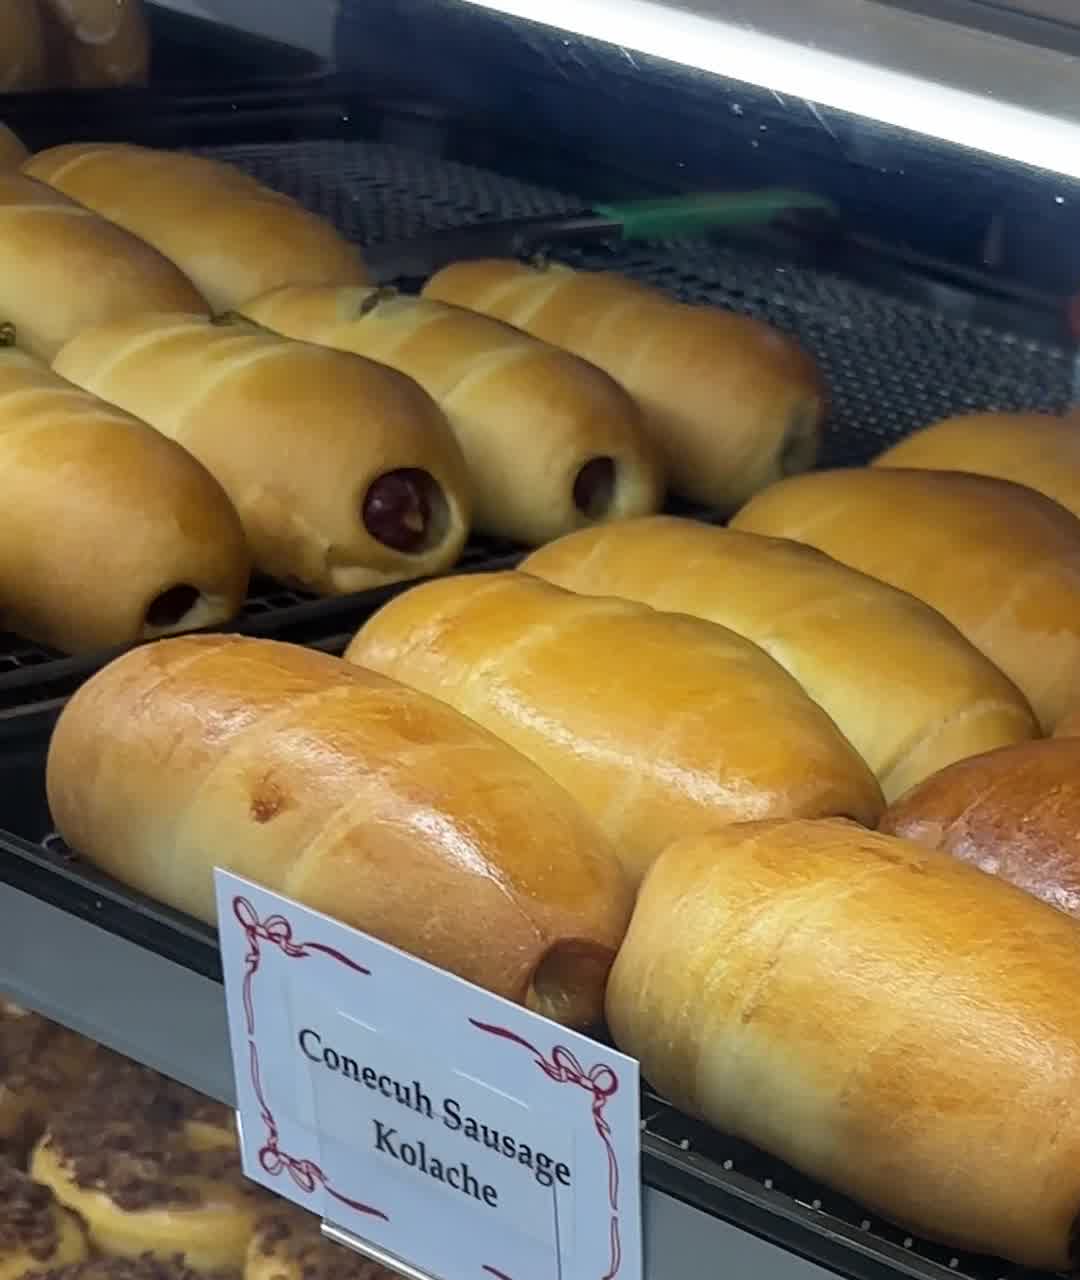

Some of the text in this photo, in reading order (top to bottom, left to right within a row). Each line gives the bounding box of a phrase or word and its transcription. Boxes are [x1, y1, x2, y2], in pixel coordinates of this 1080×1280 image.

[298, 1027, 572, 1187] Conecuh Sausage
[372, 1119, 499, 1208] Kolache
